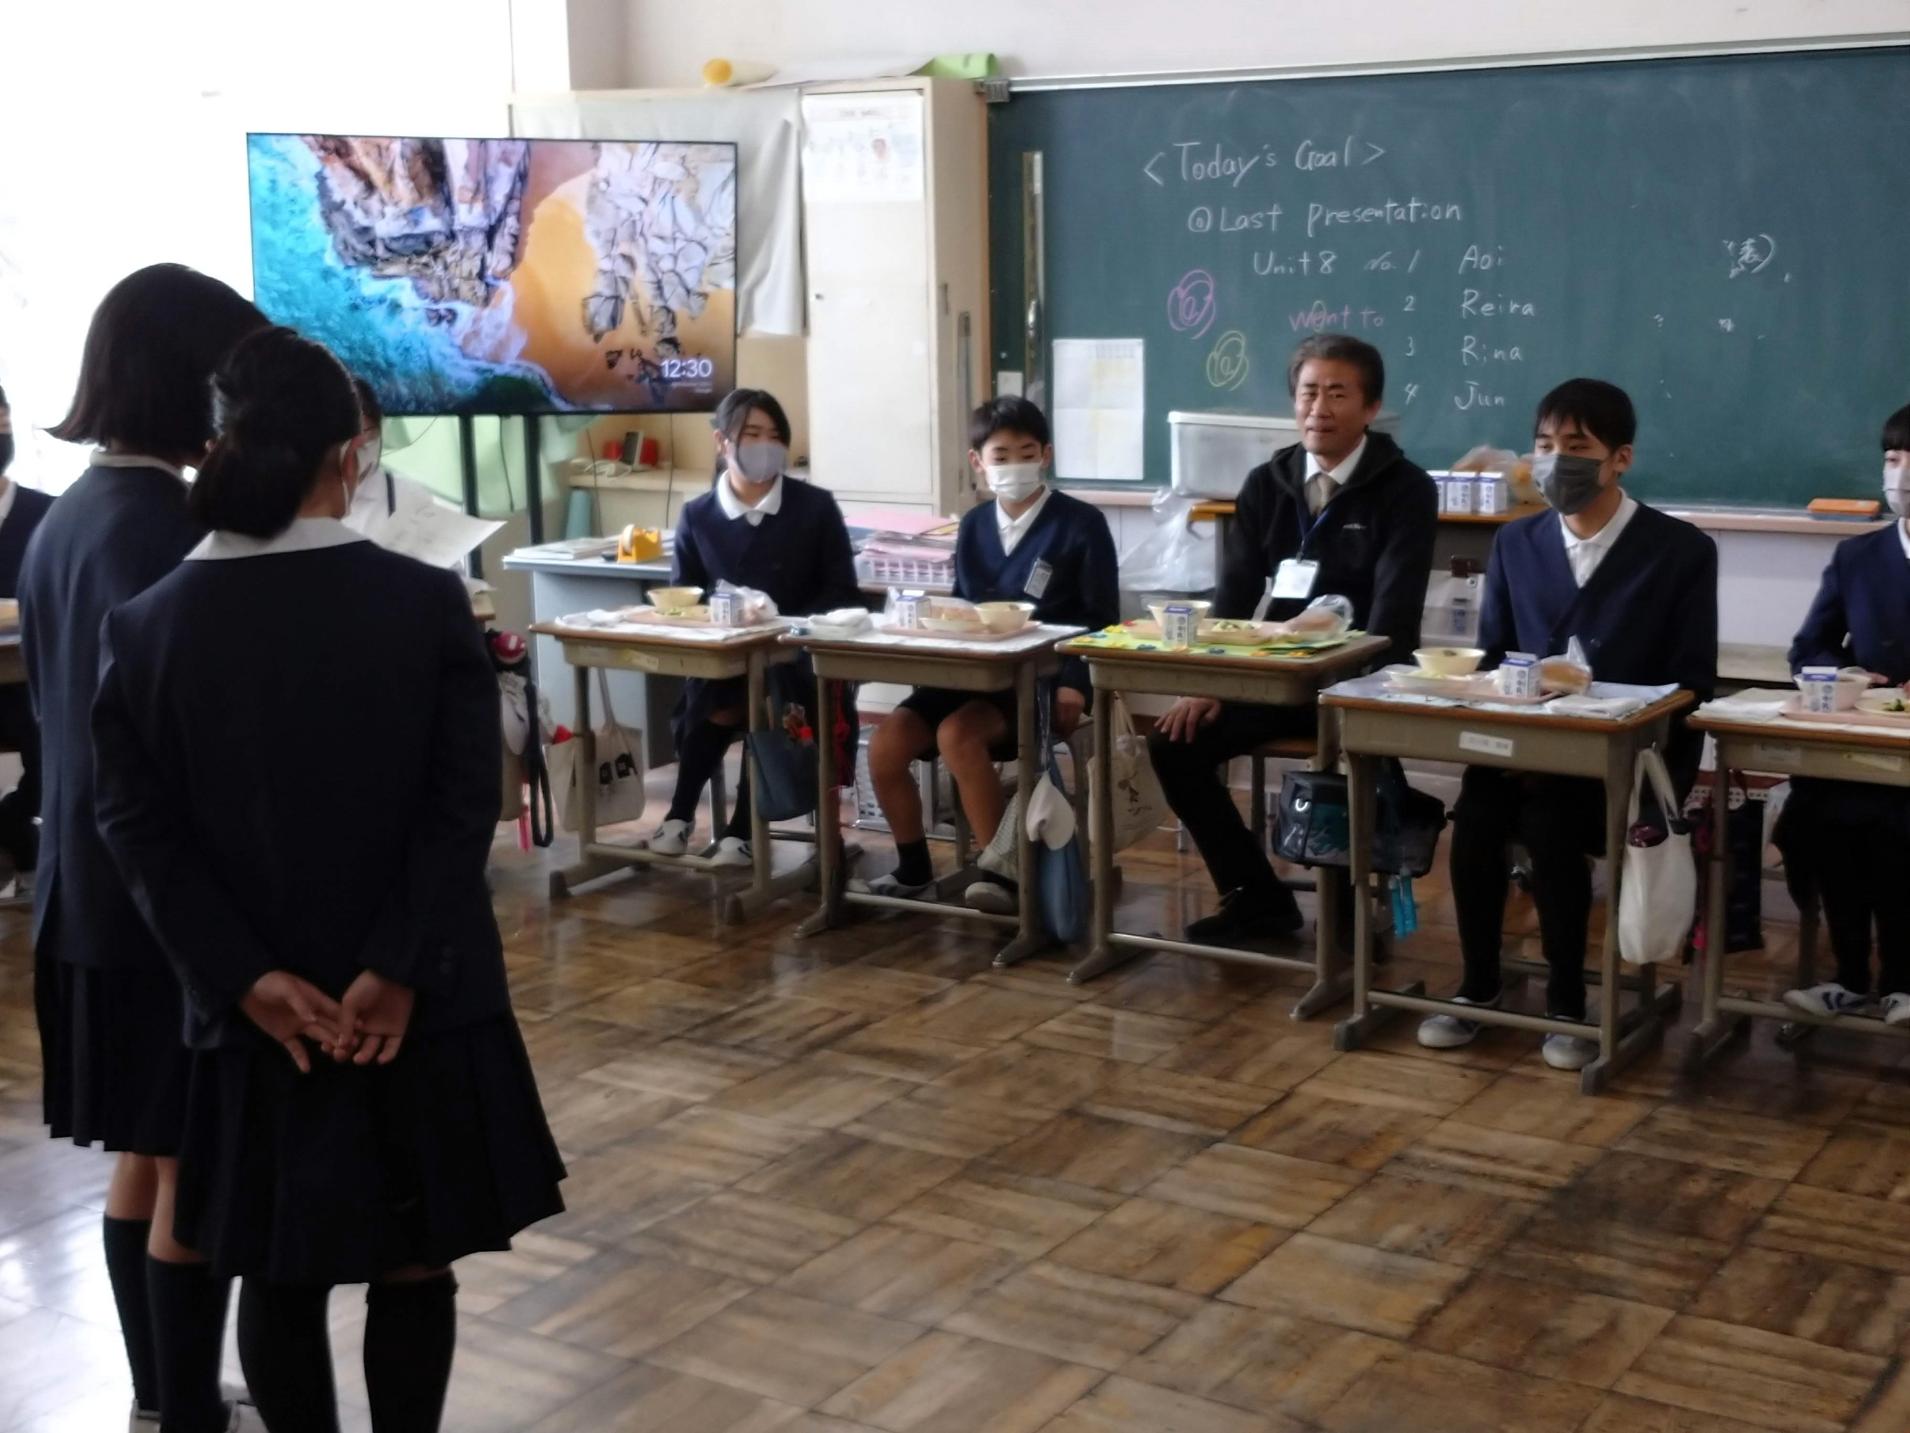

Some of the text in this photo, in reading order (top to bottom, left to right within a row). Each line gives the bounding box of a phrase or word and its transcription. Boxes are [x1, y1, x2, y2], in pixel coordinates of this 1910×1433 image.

[1457, 244, 1504, 276] Aoi
[1403, 295, 1416, 313] 2
[1405, 335, 1523, 366] 3 Rina
[661, 358, 713, 379] 12:30
[1404, 380, 1506, 410] 4 Jun
